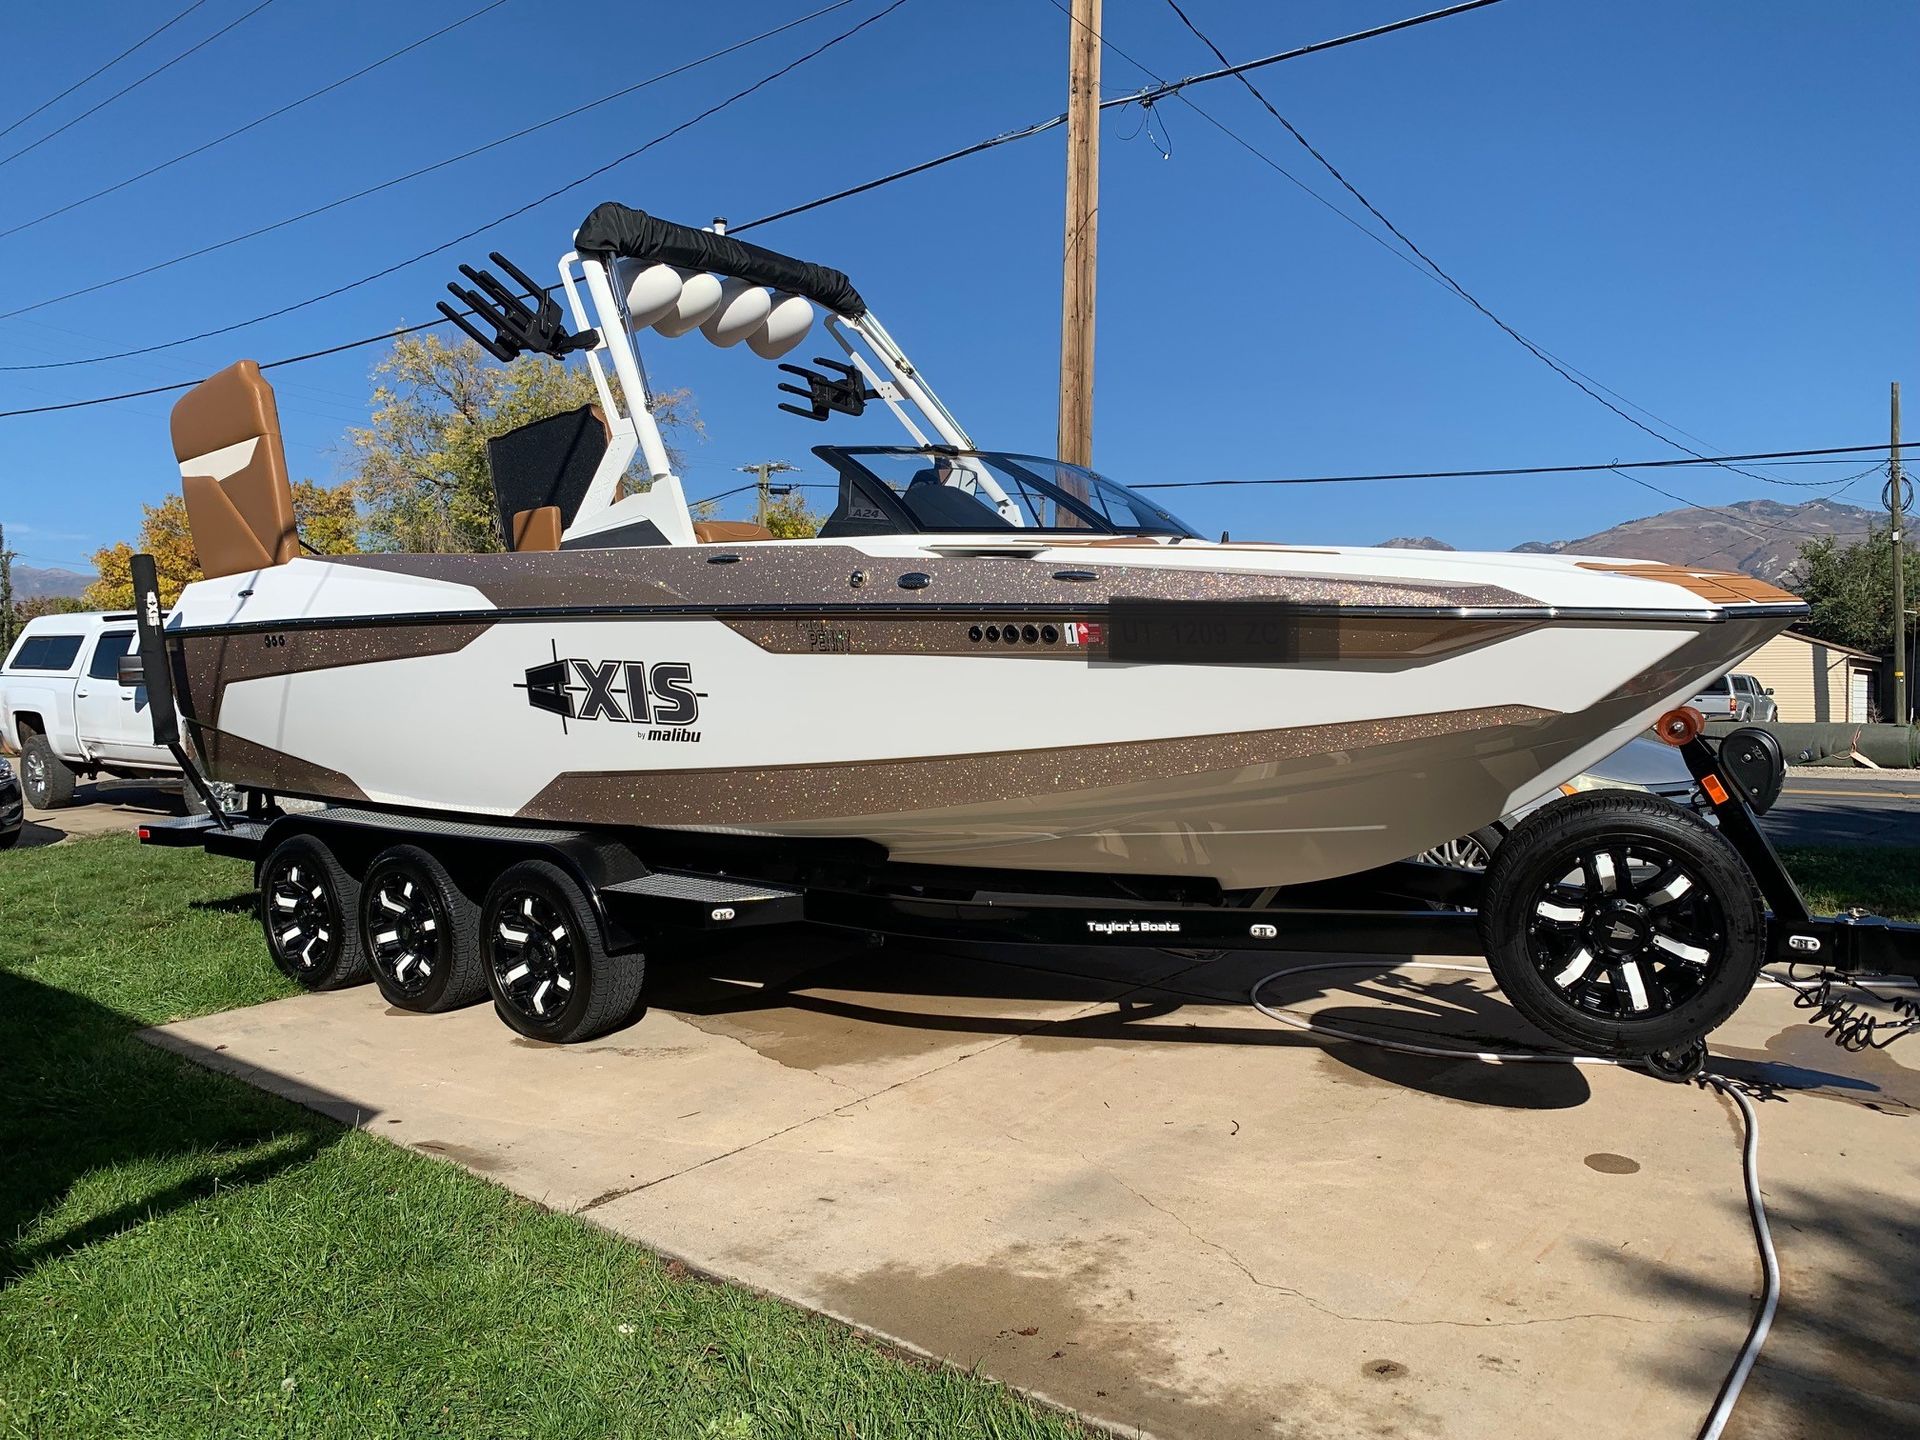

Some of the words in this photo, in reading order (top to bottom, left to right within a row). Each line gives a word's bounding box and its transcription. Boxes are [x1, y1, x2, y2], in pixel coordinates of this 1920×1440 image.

[853, 509, 880, 518] A24
[524, 658, 699, 726] AXIS
[638, 730, 646, 740] by
[648, 728, 702, 742] malibu
[1087, 921, 1140, 934] Taylor's
[1141, 922, 1180, 932] Boats
